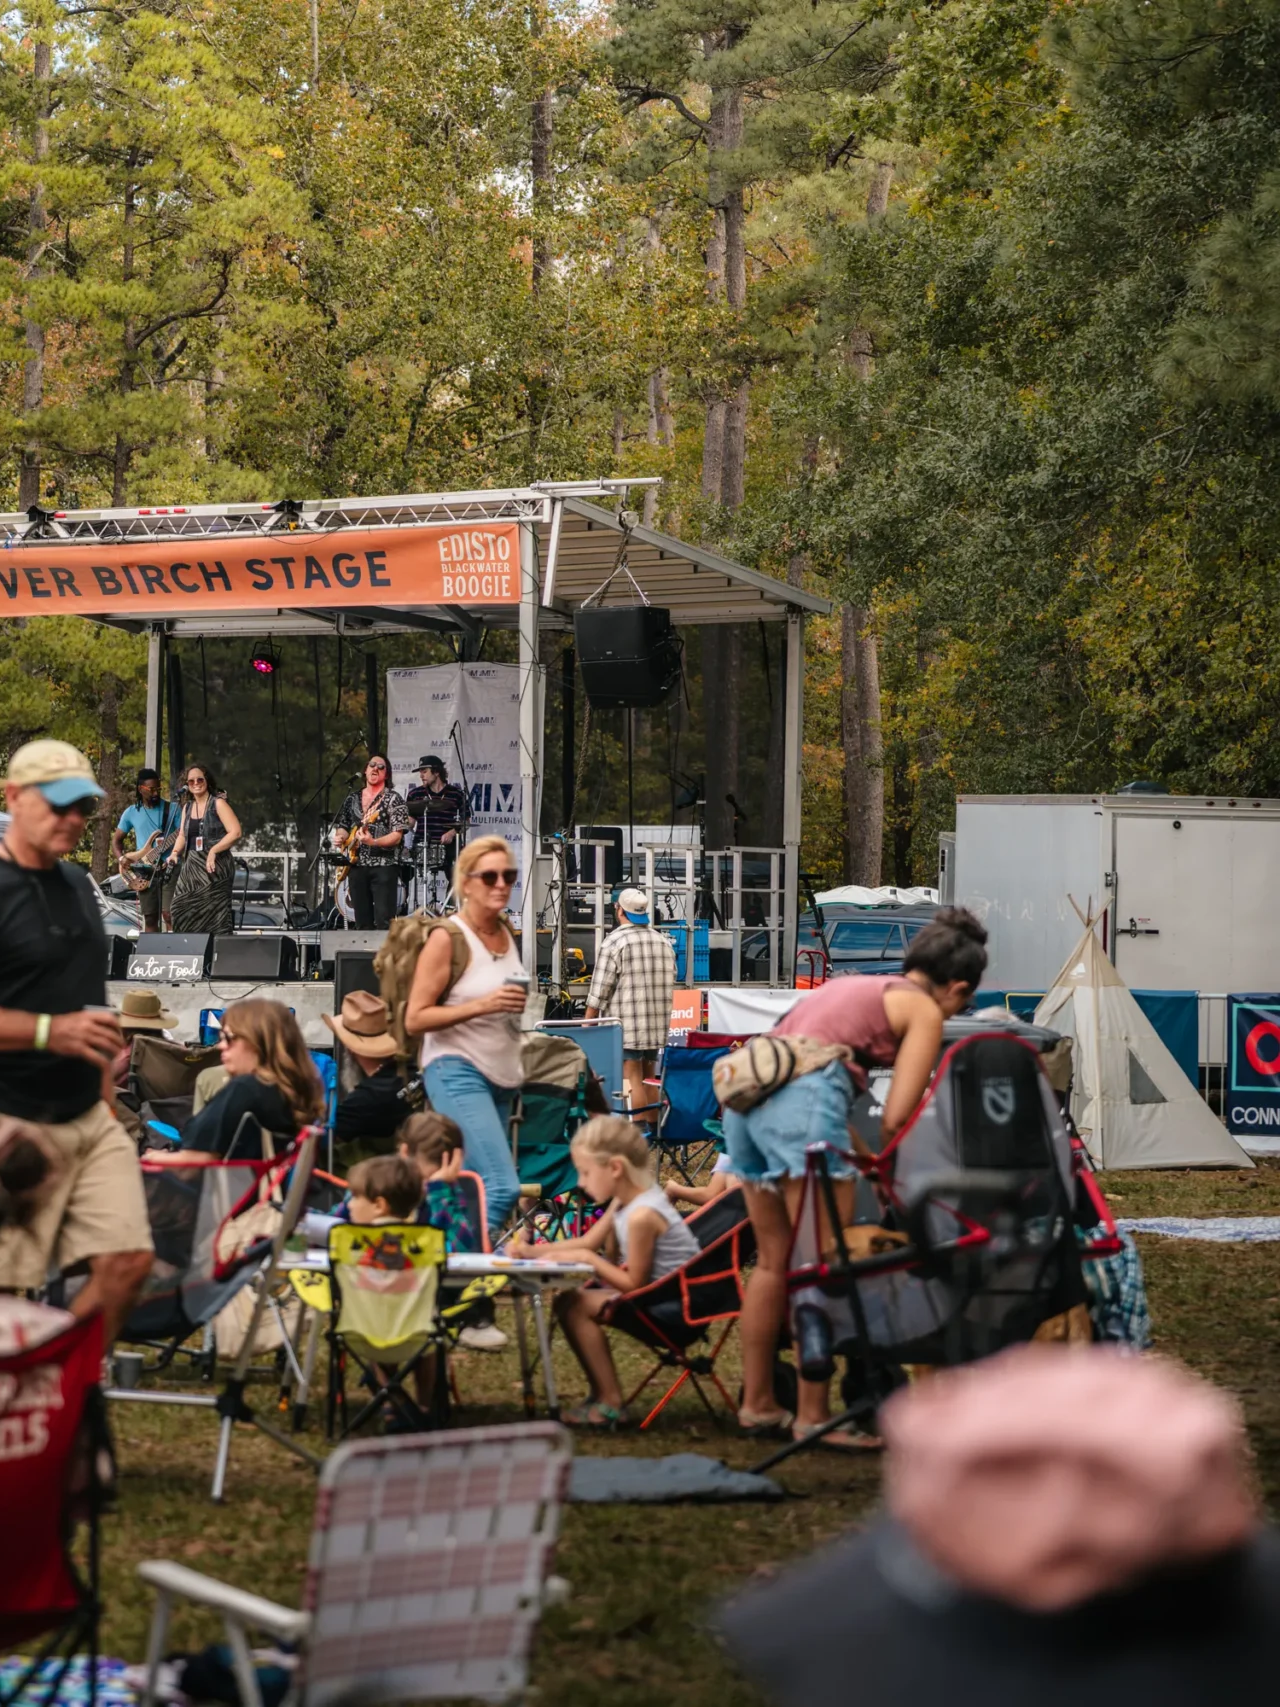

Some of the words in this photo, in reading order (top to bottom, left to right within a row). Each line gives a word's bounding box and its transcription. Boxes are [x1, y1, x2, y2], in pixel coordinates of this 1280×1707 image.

[437, 531, 510, 562] EDISTO
[91, 561, 232, 596] BIRCH
[245, 550, 391, 591] STAGE
[441, 562, 511, 574] BLACKWATER
[442, 575, 511, 597] BOOGIE
[128, 956, 166, 978] Gator
[168, 957, 200, 978] Food
